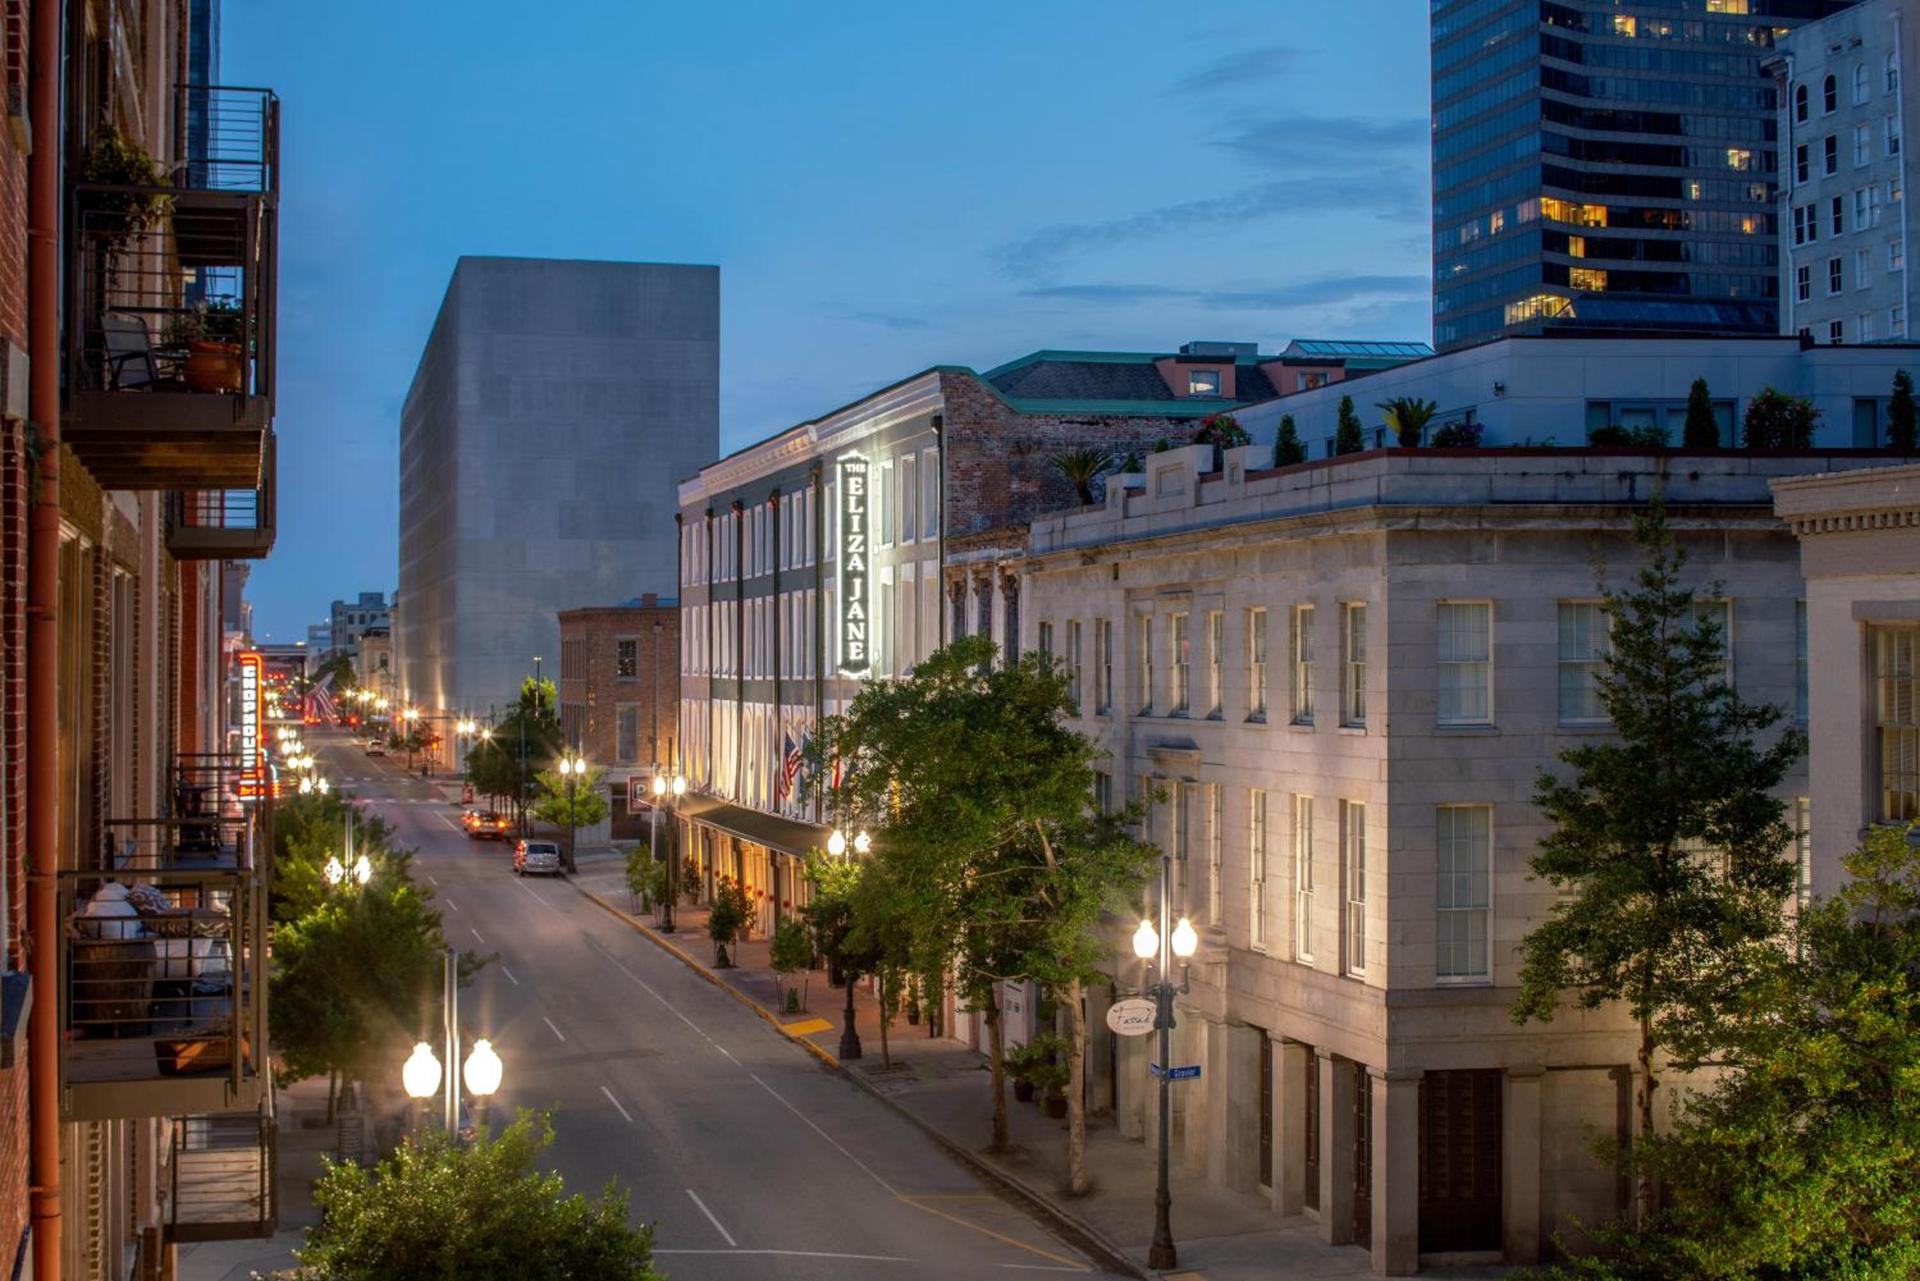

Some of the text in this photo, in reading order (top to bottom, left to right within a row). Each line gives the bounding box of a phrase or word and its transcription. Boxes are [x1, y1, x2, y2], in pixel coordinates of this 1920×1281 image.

[845, 463, 867, 474] THE
[847, 476, 866, 572] ELIZA
[847, 578, 866, 661] JANE
